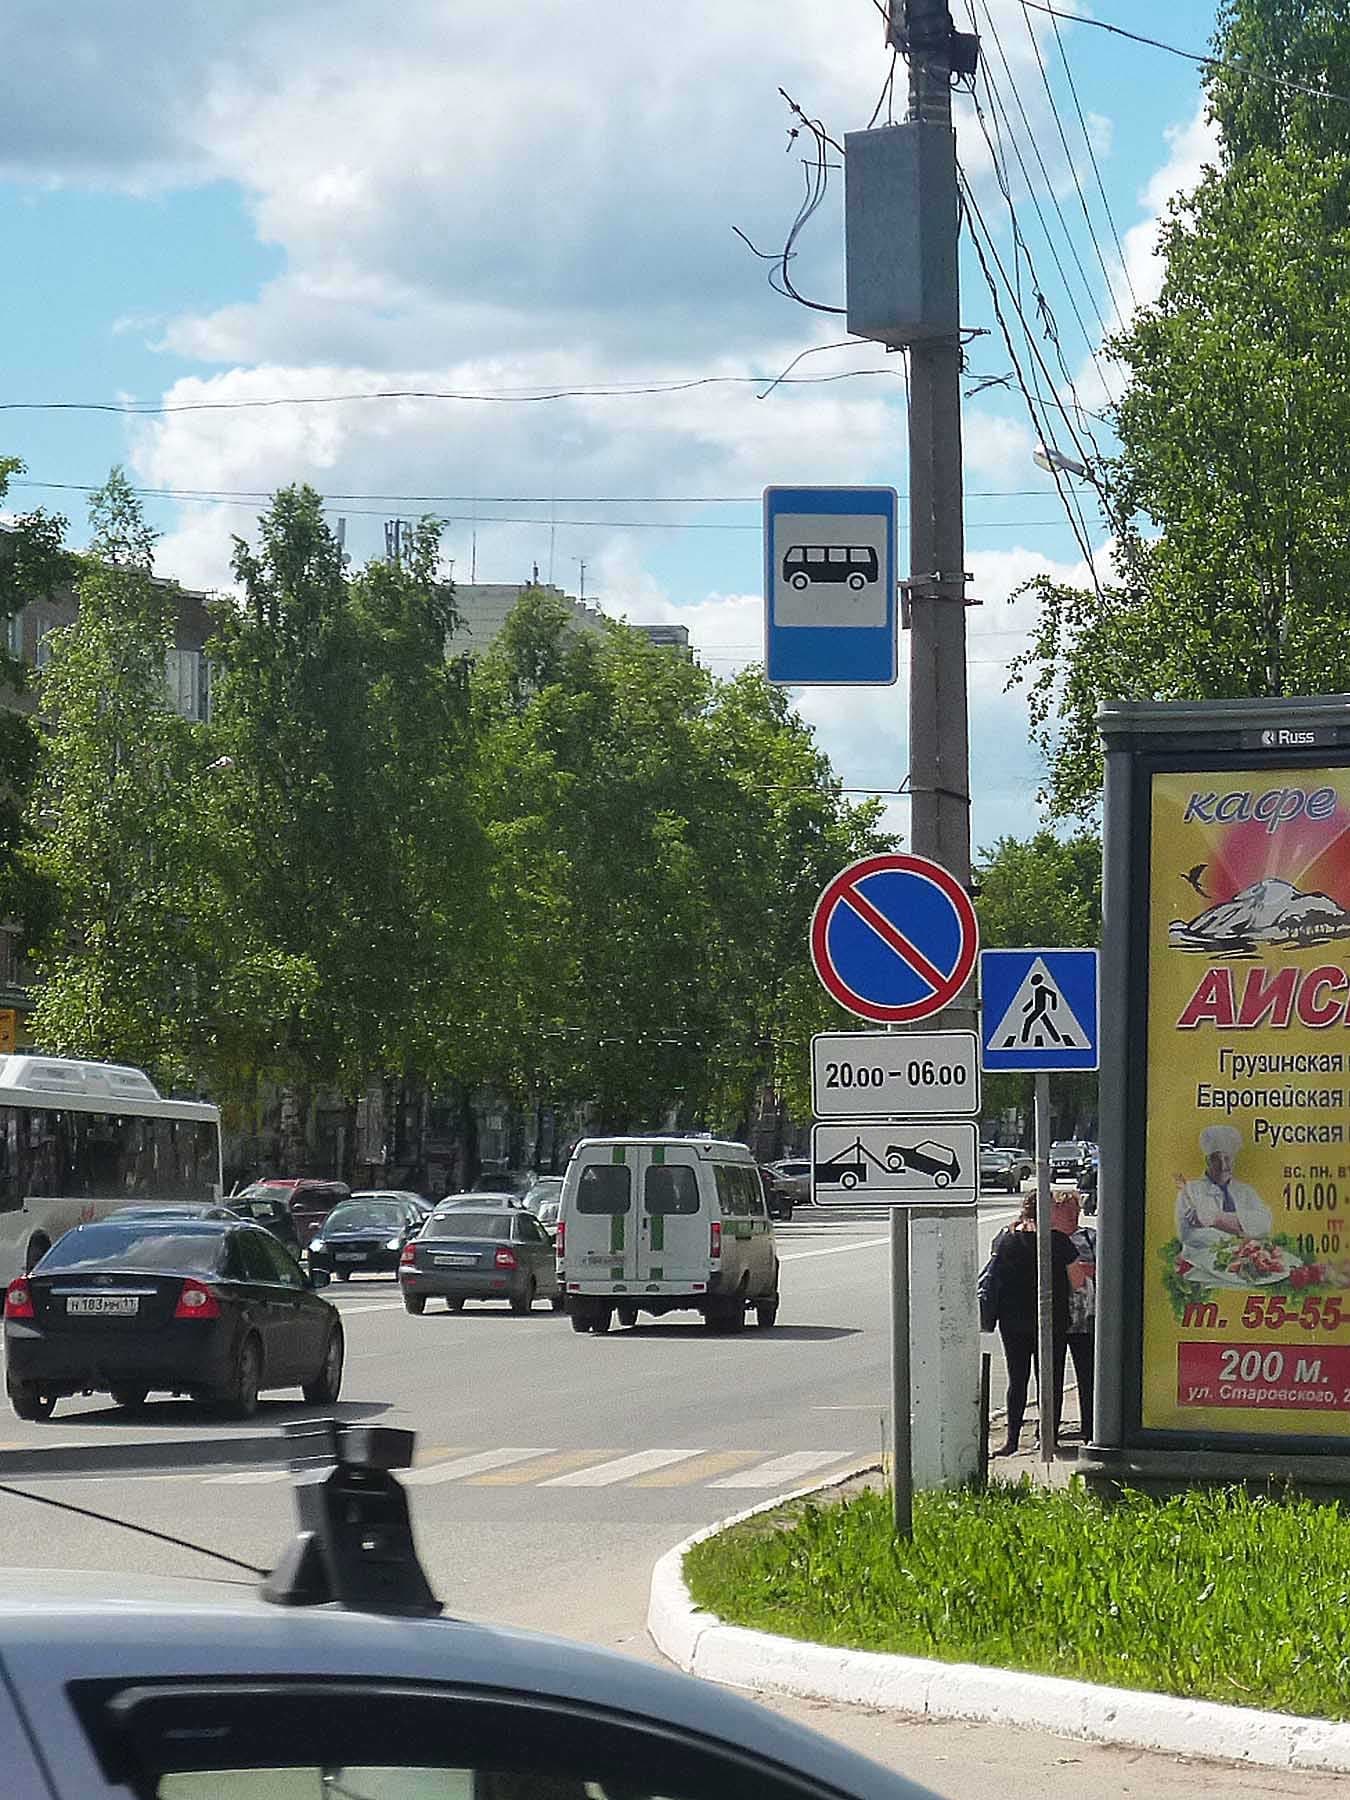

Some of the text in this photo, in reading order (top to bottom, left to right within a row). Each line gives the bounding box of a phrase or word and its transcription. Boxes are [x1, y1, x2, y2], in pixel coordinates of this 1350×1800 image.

[1279, 730, 1314, 744] Russ
[1184, 786, 1336, 833] кафе
[1219, 1049, 1343, 1080] Грузинская
[1197, 1083, 1343, 1115] Европейская
[1254, 1118, 1343, 1148] Русская
[1283, 1182, 1337, 1211] 10.00
[1296, 1233, 1340, 1254] 10.00
[1219, 1350, 1329, 1383] 200 м.
